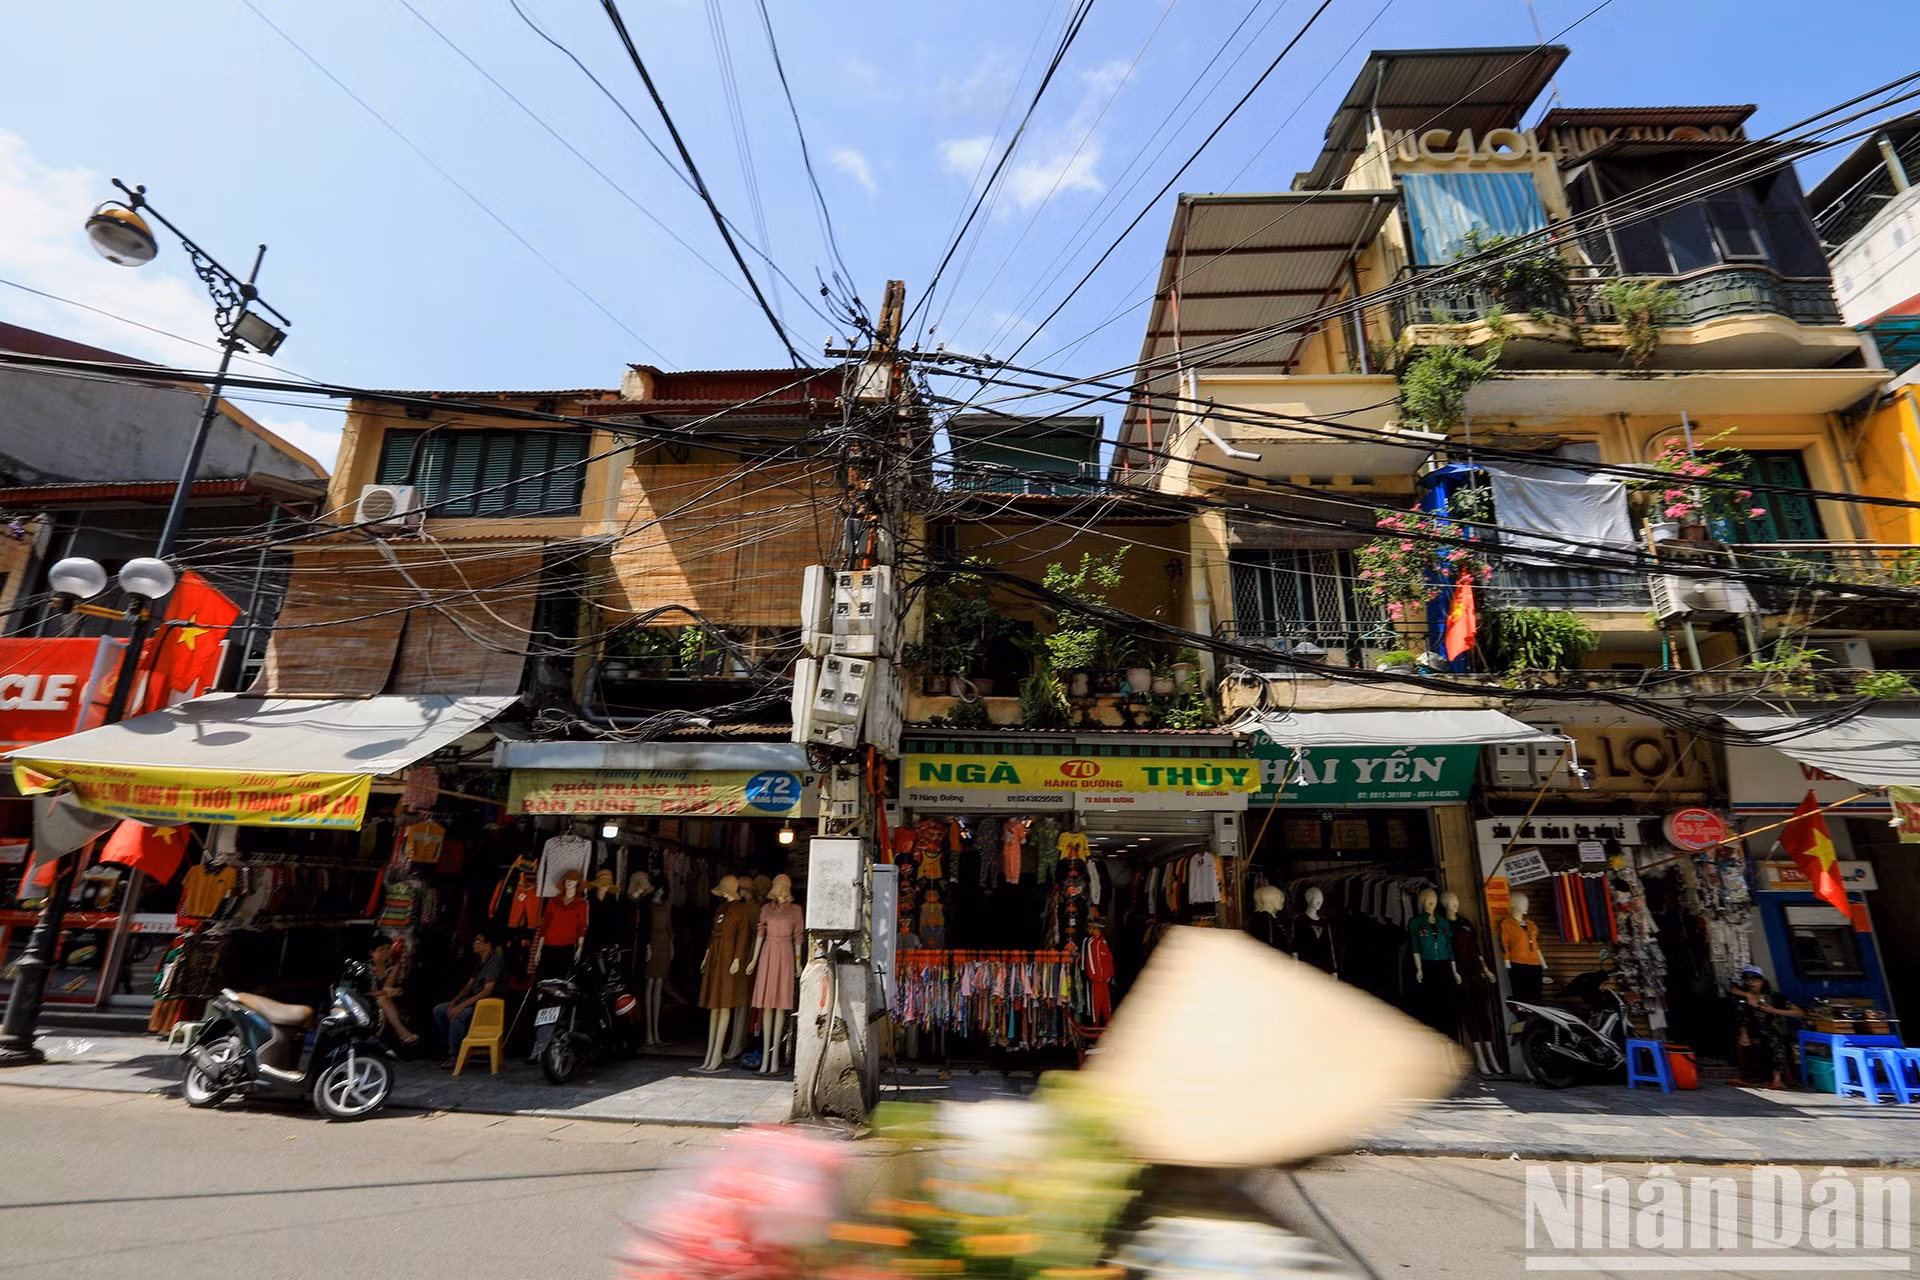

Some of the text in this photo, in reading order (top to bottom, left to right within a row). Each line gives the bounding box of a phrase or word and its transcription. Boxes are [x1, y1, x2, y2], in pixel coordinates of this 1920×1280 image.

[919, 760, 1021, 785] NGÀ
[1066, 762, 1096, 777] 70
[1141, 762, 1250, 787] THÙY
[1258, 745, 1447, 785] HẢI YẾN
[601, 783, 670, 797] TRANG
[757, 775, 791, 795] 72
[1044, 778, 1077, 788] HÀNG
[237, 791, 292, 813] TRANG
[332, 794, 361, 816] EM
